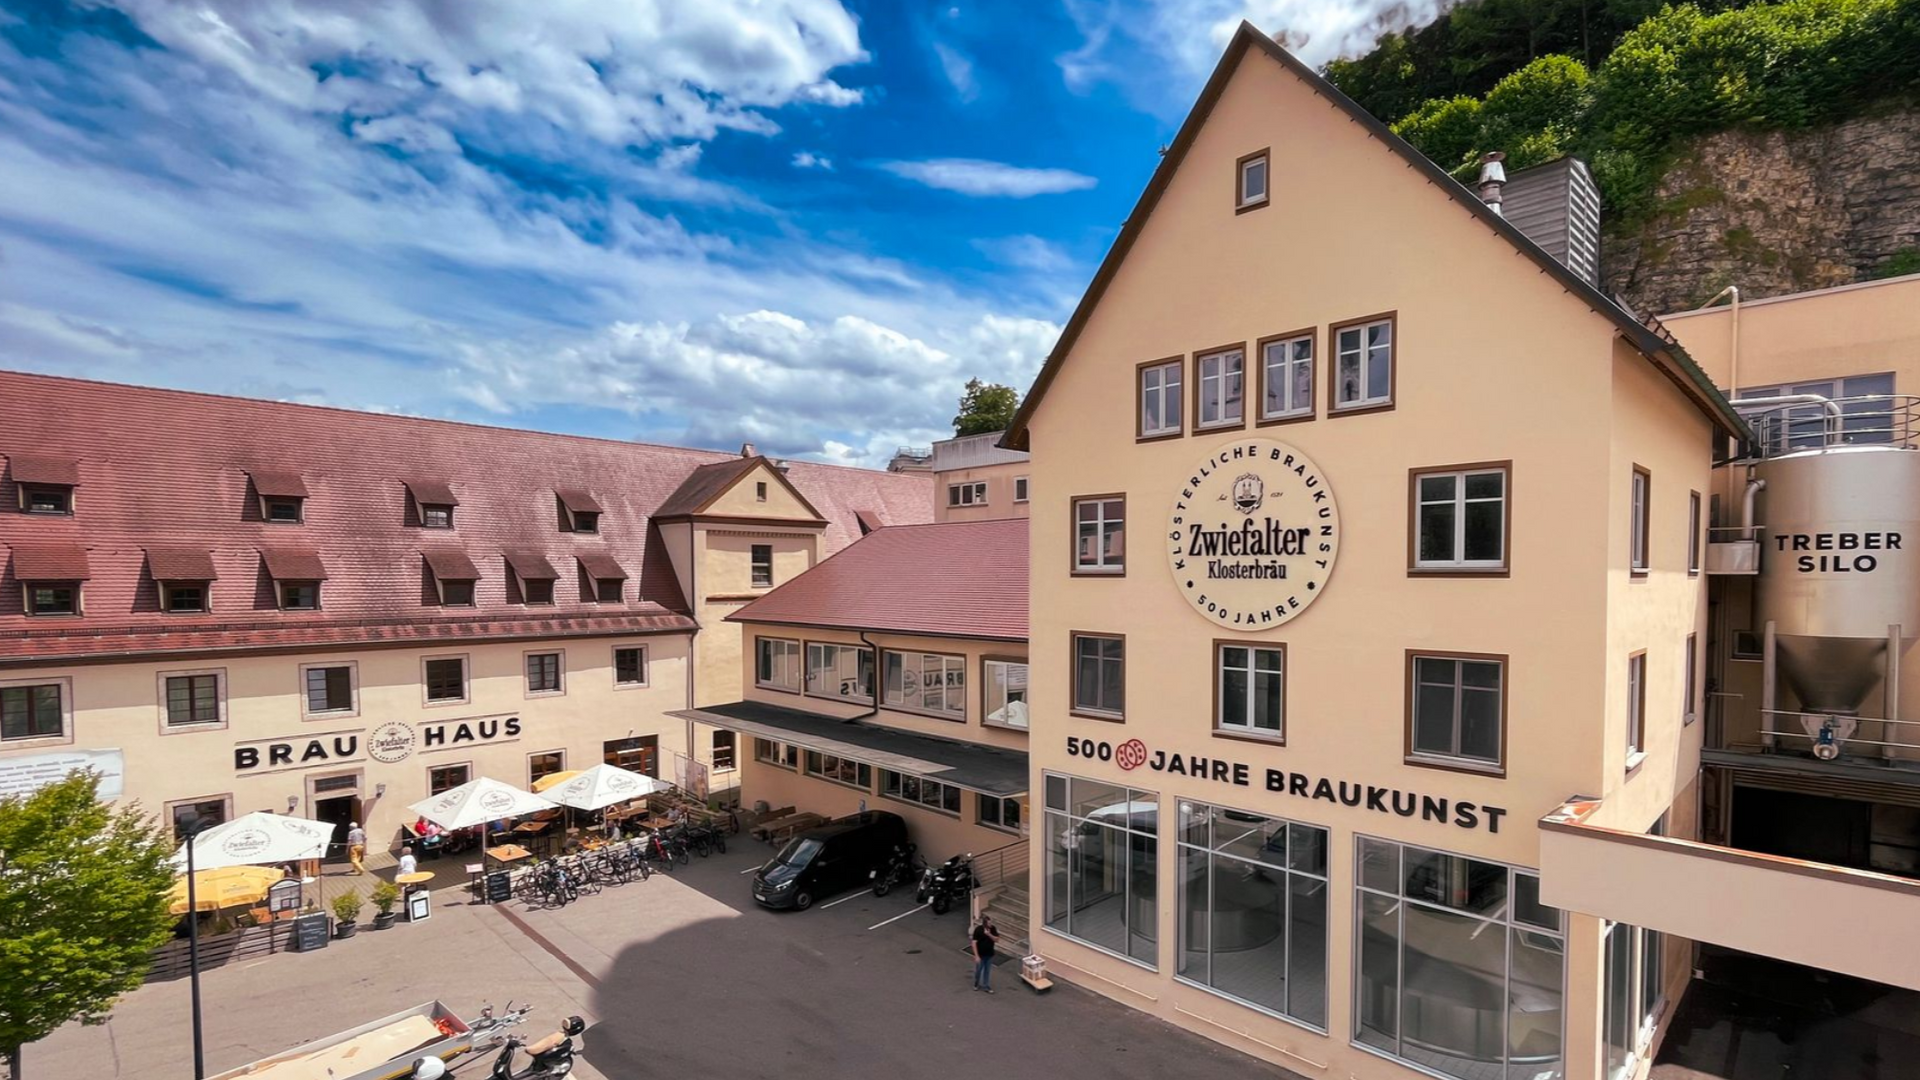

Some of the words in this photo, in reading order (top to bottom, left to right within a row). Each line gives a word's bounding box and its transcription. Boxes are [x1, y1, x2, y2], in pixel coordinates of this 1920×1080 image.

[1169, 445, 1257, 569] KLÖSTERLICHE
[1270, 448, 1332, 569] BRAUKUNST
[1188, 517, 1311, 557] Zwiefalter
[1774, 532, 1902, 551] TREBER
[1207, 559, 1287, 580] Klosterbräu
[1797, 555, 1877, 573] SILO
[1197, 594, 1228, 619] 500
[1234, 596, 1300, 624] JAHRE
[235, 735, 358, 770] BRAU
[424, 717, 522, 747] HAUS
[1067, 736, 1112, 762] 500
[1150, 750, 1249, 787] JAHRE
[1266, 768, 1507, 834] BRAUKUNST
